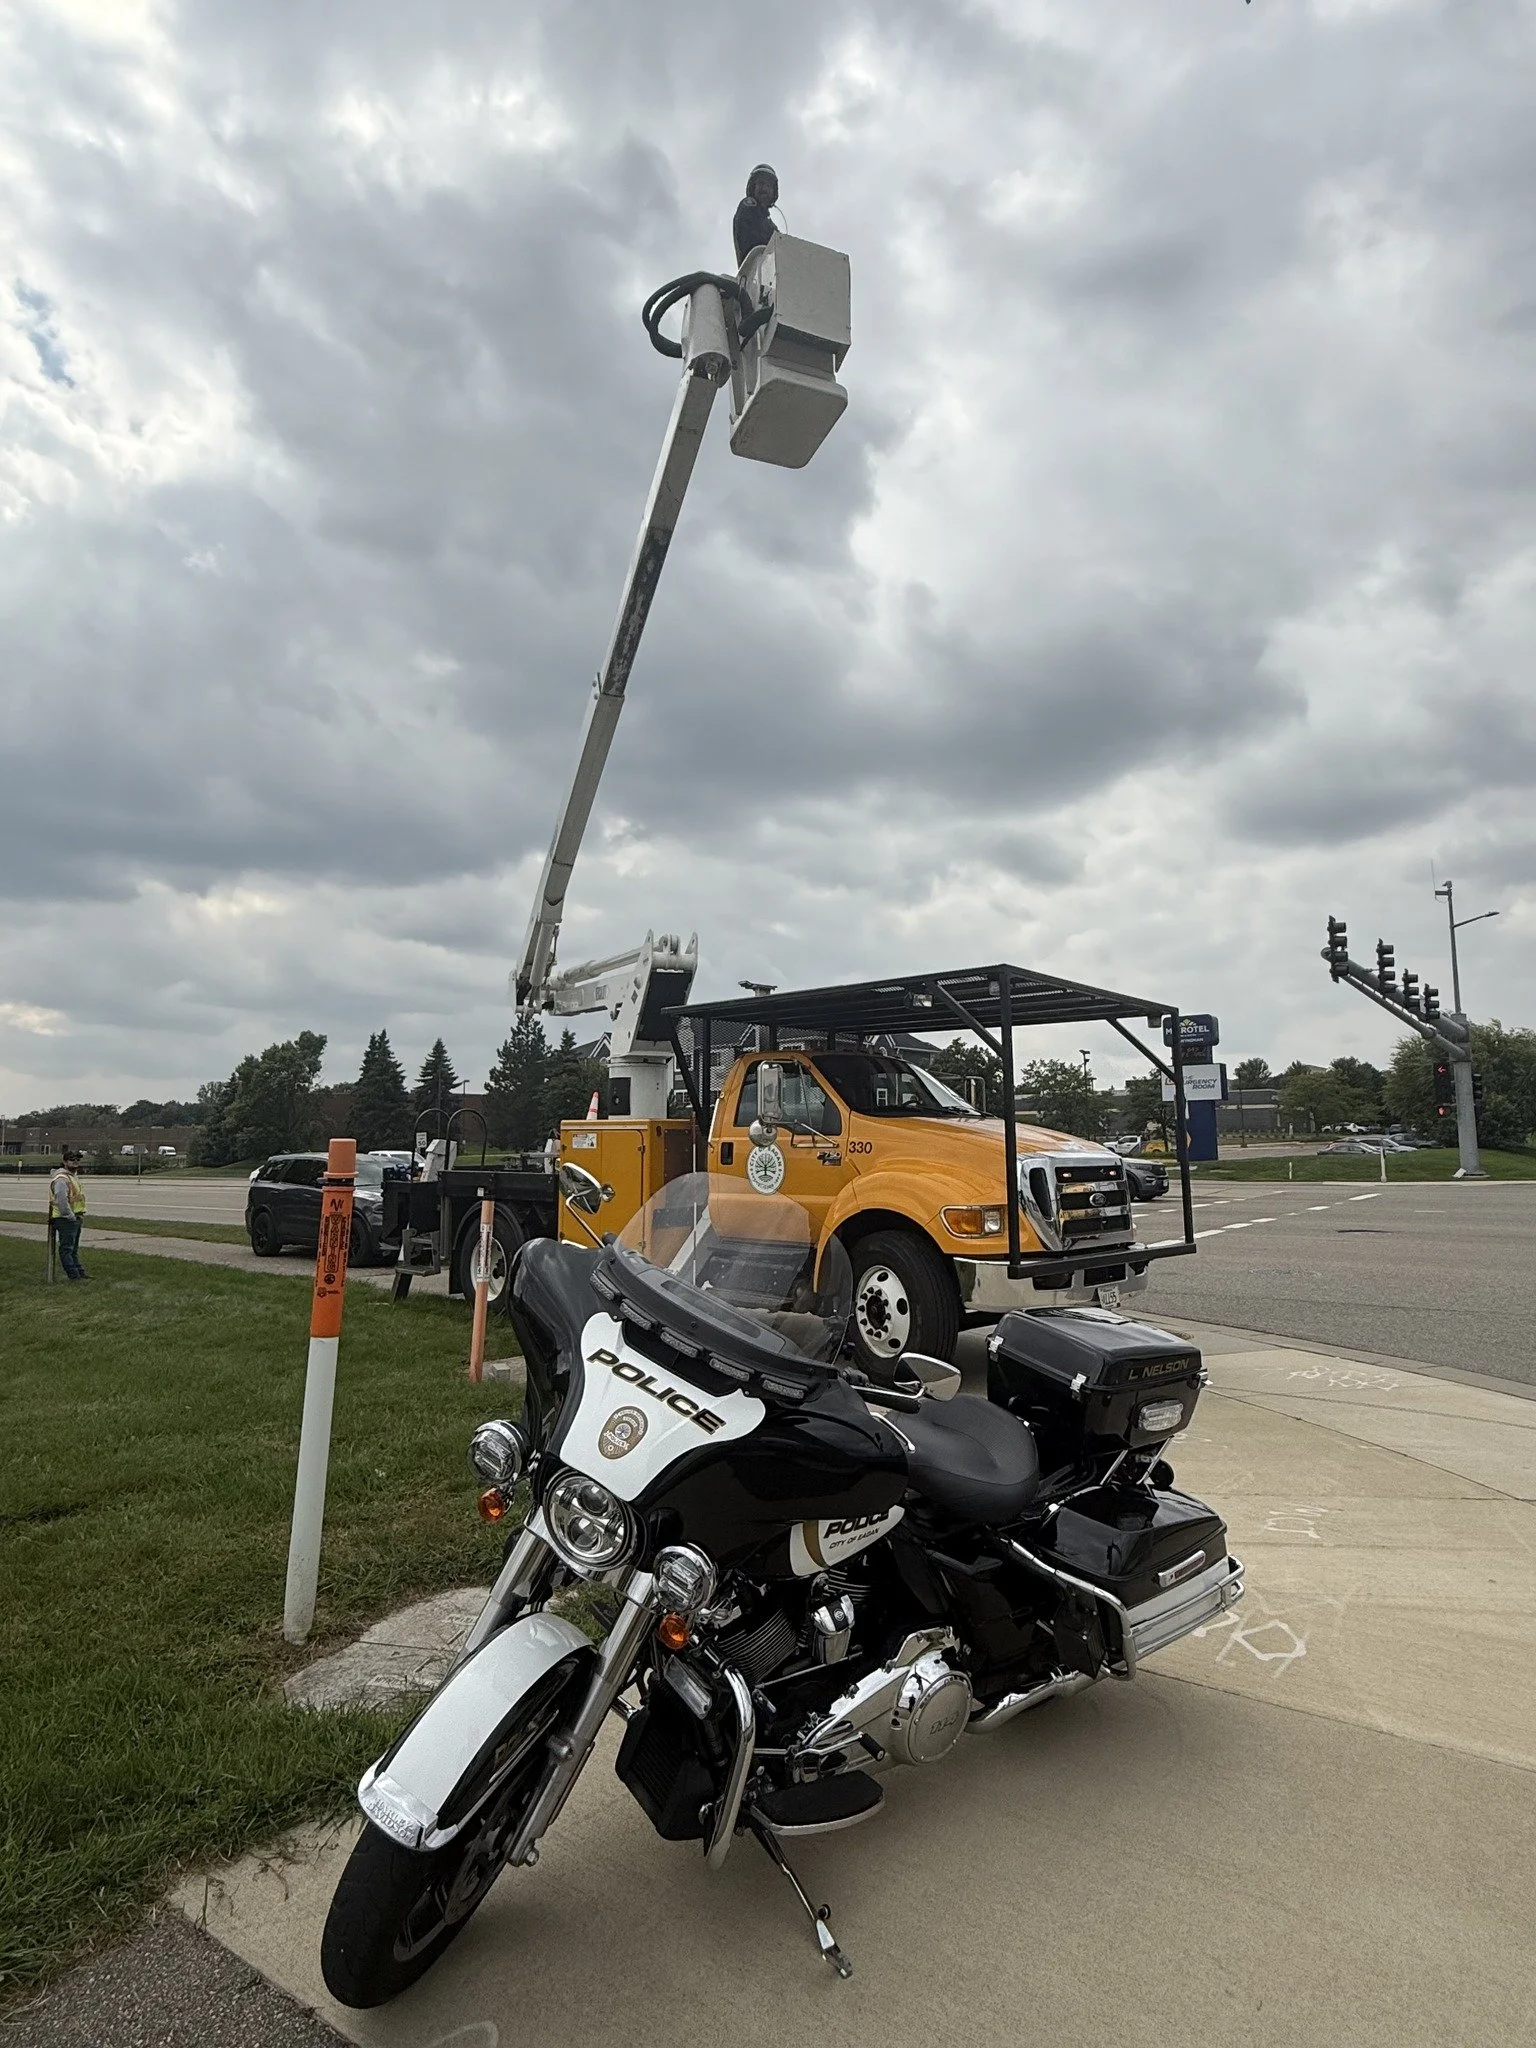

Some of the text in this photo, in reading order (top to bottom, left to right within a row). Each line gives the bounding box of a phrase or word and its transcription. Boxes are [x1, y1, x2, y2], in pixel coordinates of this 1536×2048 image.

[1165, 1024, 1210, 1035] MROTEL
[849, 1141, 873, 1154] 330
[1141, 1358, 1190, 1379] NELSON
[586, 1348, 727, 1435] POLICE
[829, 1528, 880, 1549] CITY OF EAGAN
